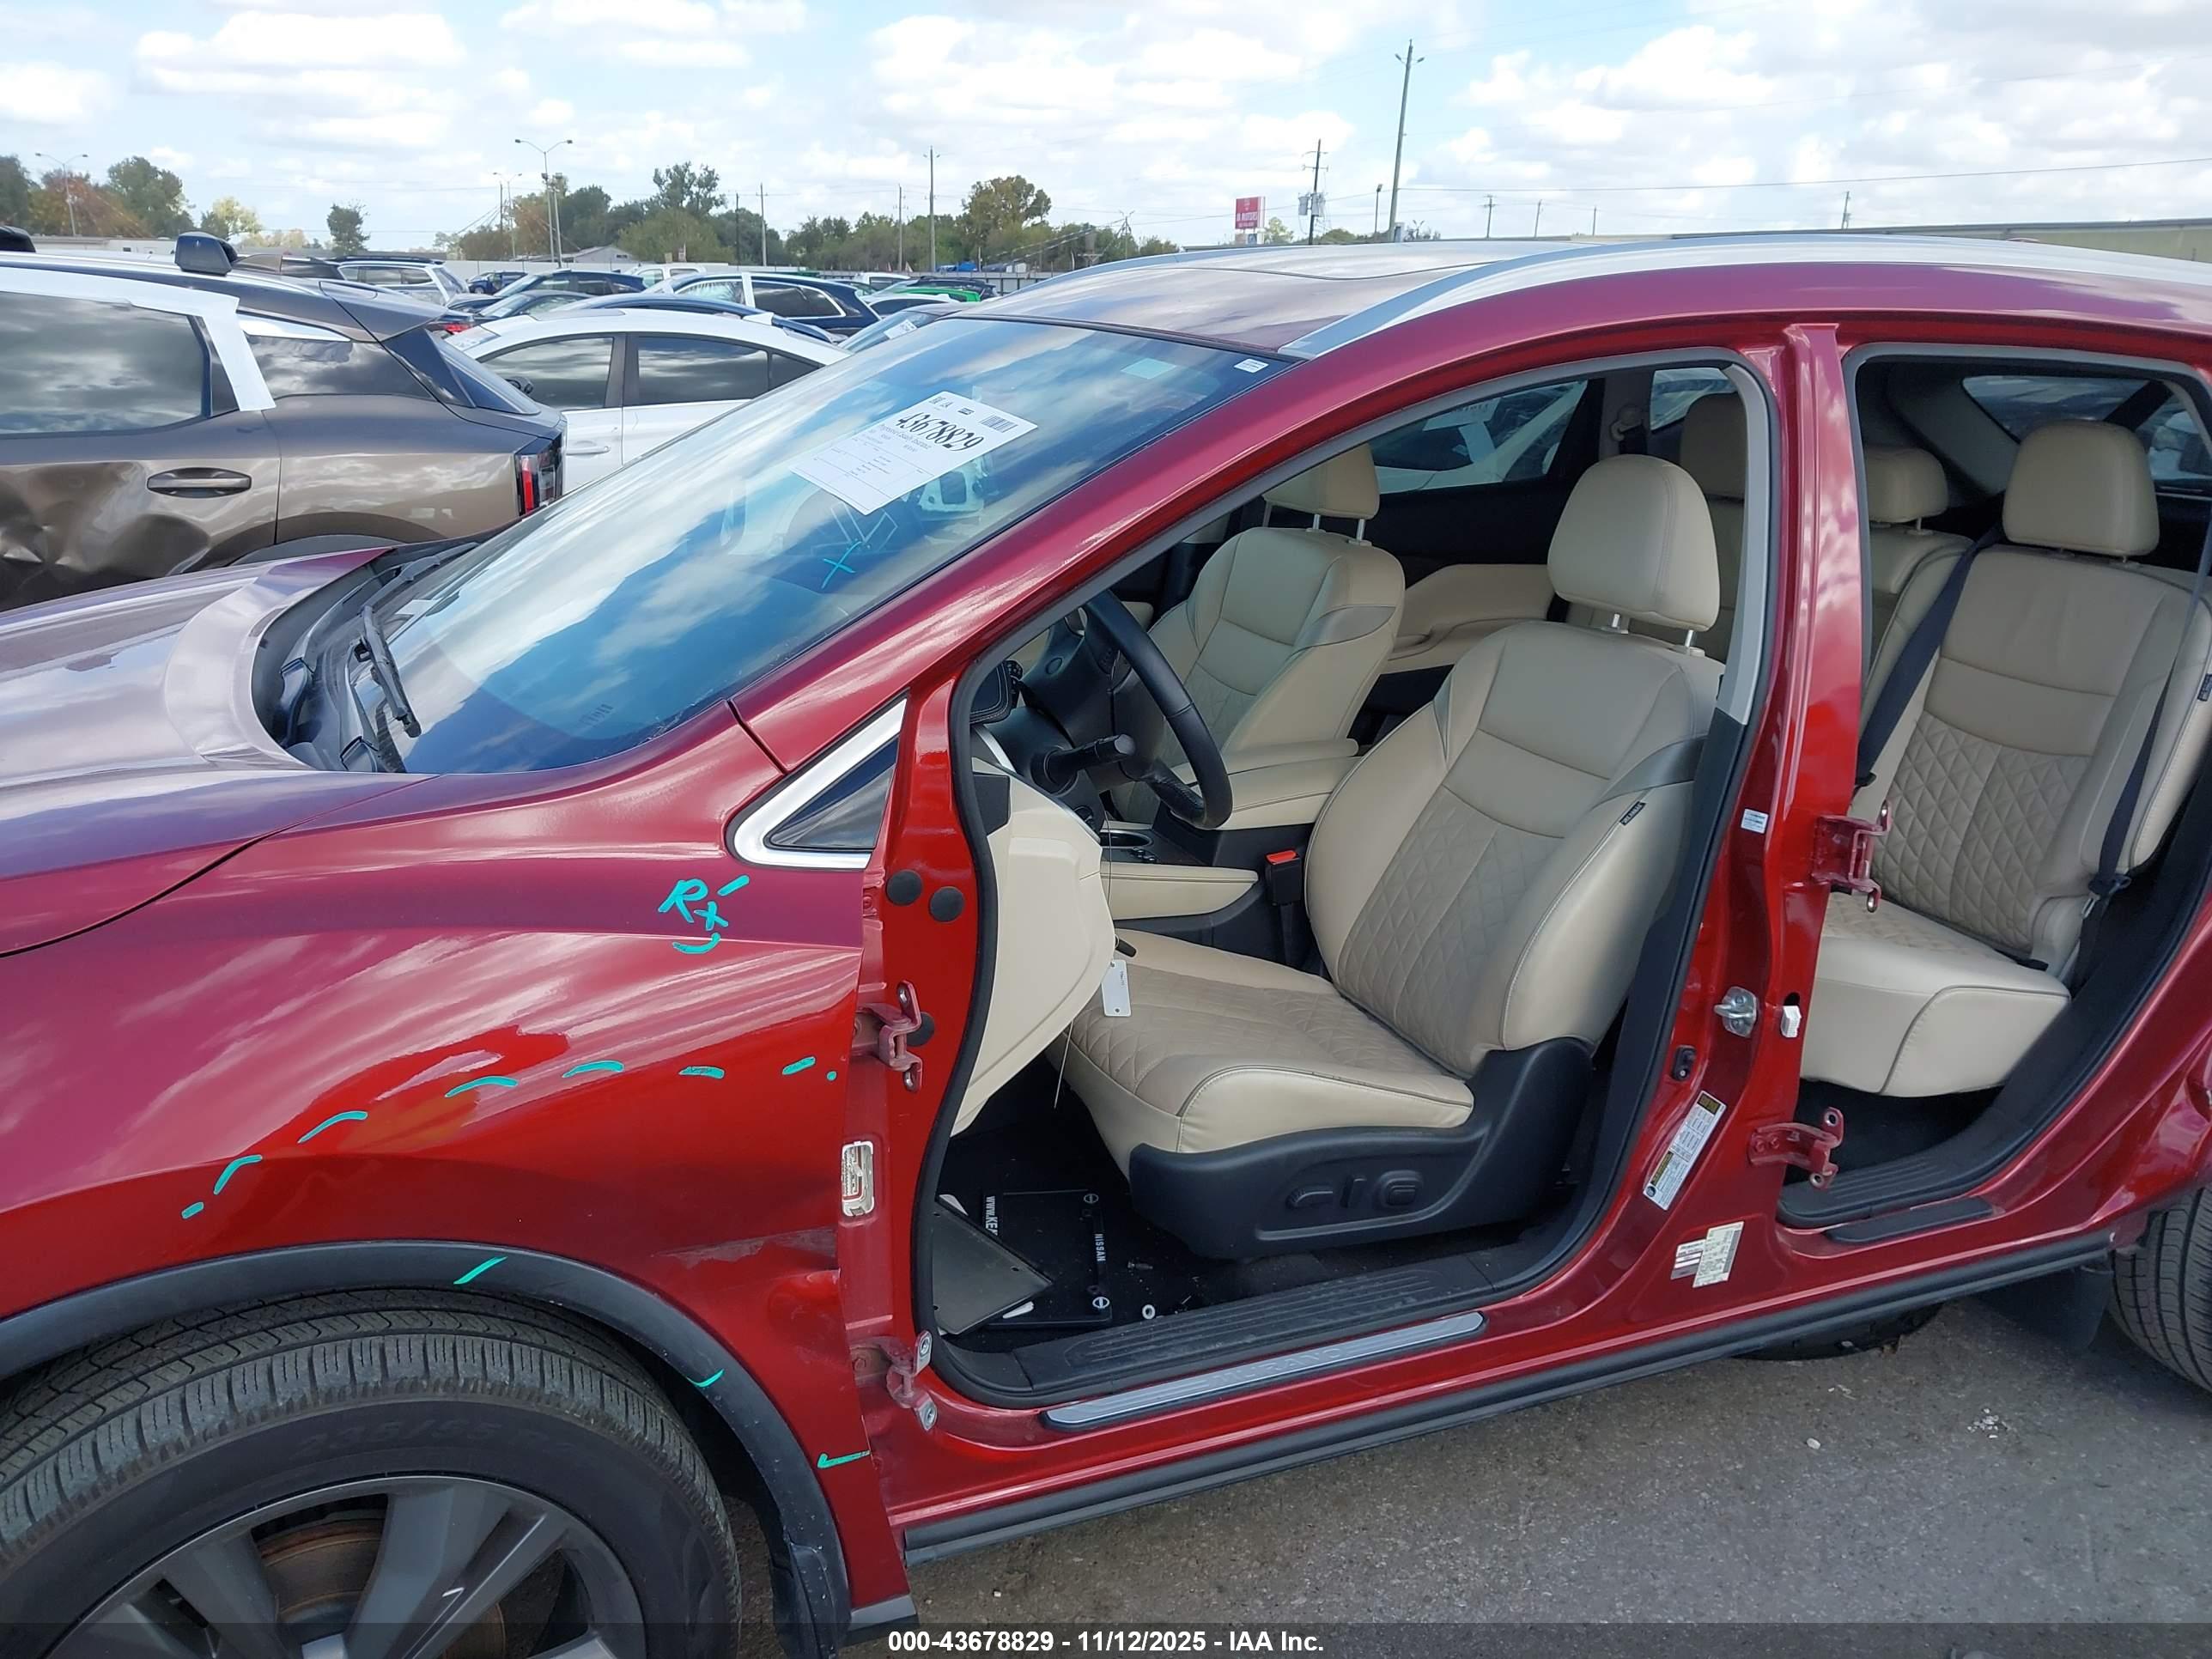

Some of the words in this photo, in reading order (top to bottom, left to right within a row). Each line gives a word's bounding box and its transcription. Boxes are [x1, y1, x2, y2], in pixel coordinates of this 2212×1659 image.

[896, 411, 985, 452] 43678829
[1094, 1232, 1107, 1262] NISSAN
[1212, 1347, 1342, 1382] MURANO
